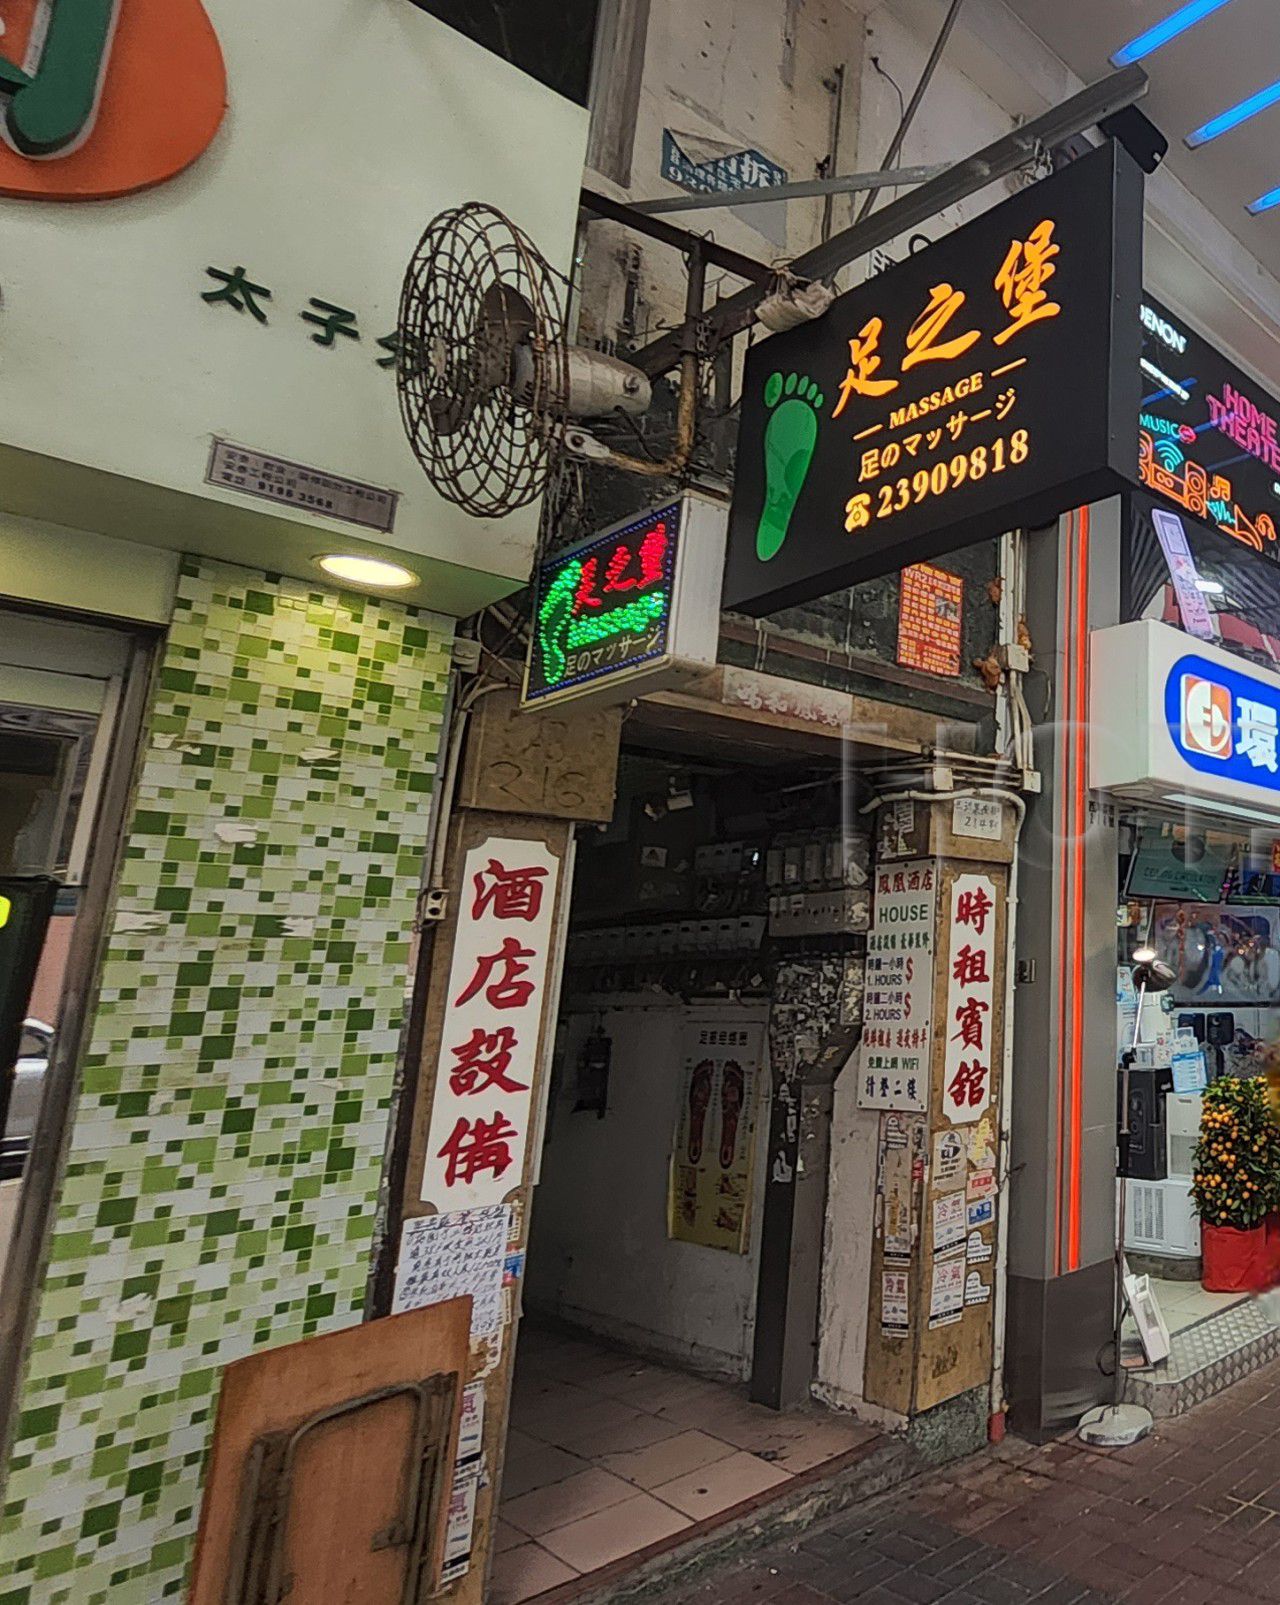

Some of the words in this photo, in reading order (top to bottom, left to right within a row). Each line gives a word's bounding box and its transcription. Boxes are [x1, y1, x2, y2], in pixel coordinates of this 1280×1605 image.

[832, 220, 1061, 418] 足之堡
[889, 370, 984, 429] MASSAGE
[1222, 383, 1280, 445] HOME
[857, 388, 1018, 483] 足のマッサージ
[1138, 413, 1180, 437] MUSIC
[876, 428, 1029, 519] 23909818
[564, 626, 662, 678] 足のマッサージ
[878, 903, 929, 923] HOUSE
[874, 973, 903, 986] HOURS
[905, 956, 914, 984] $
[436, 858, 551, 1188] 酒店設備
[873, 1008, 902, 1021] HOURS
[903, 992, 912, 1020] $
[901, 1056, 920, 1071] WIFI
